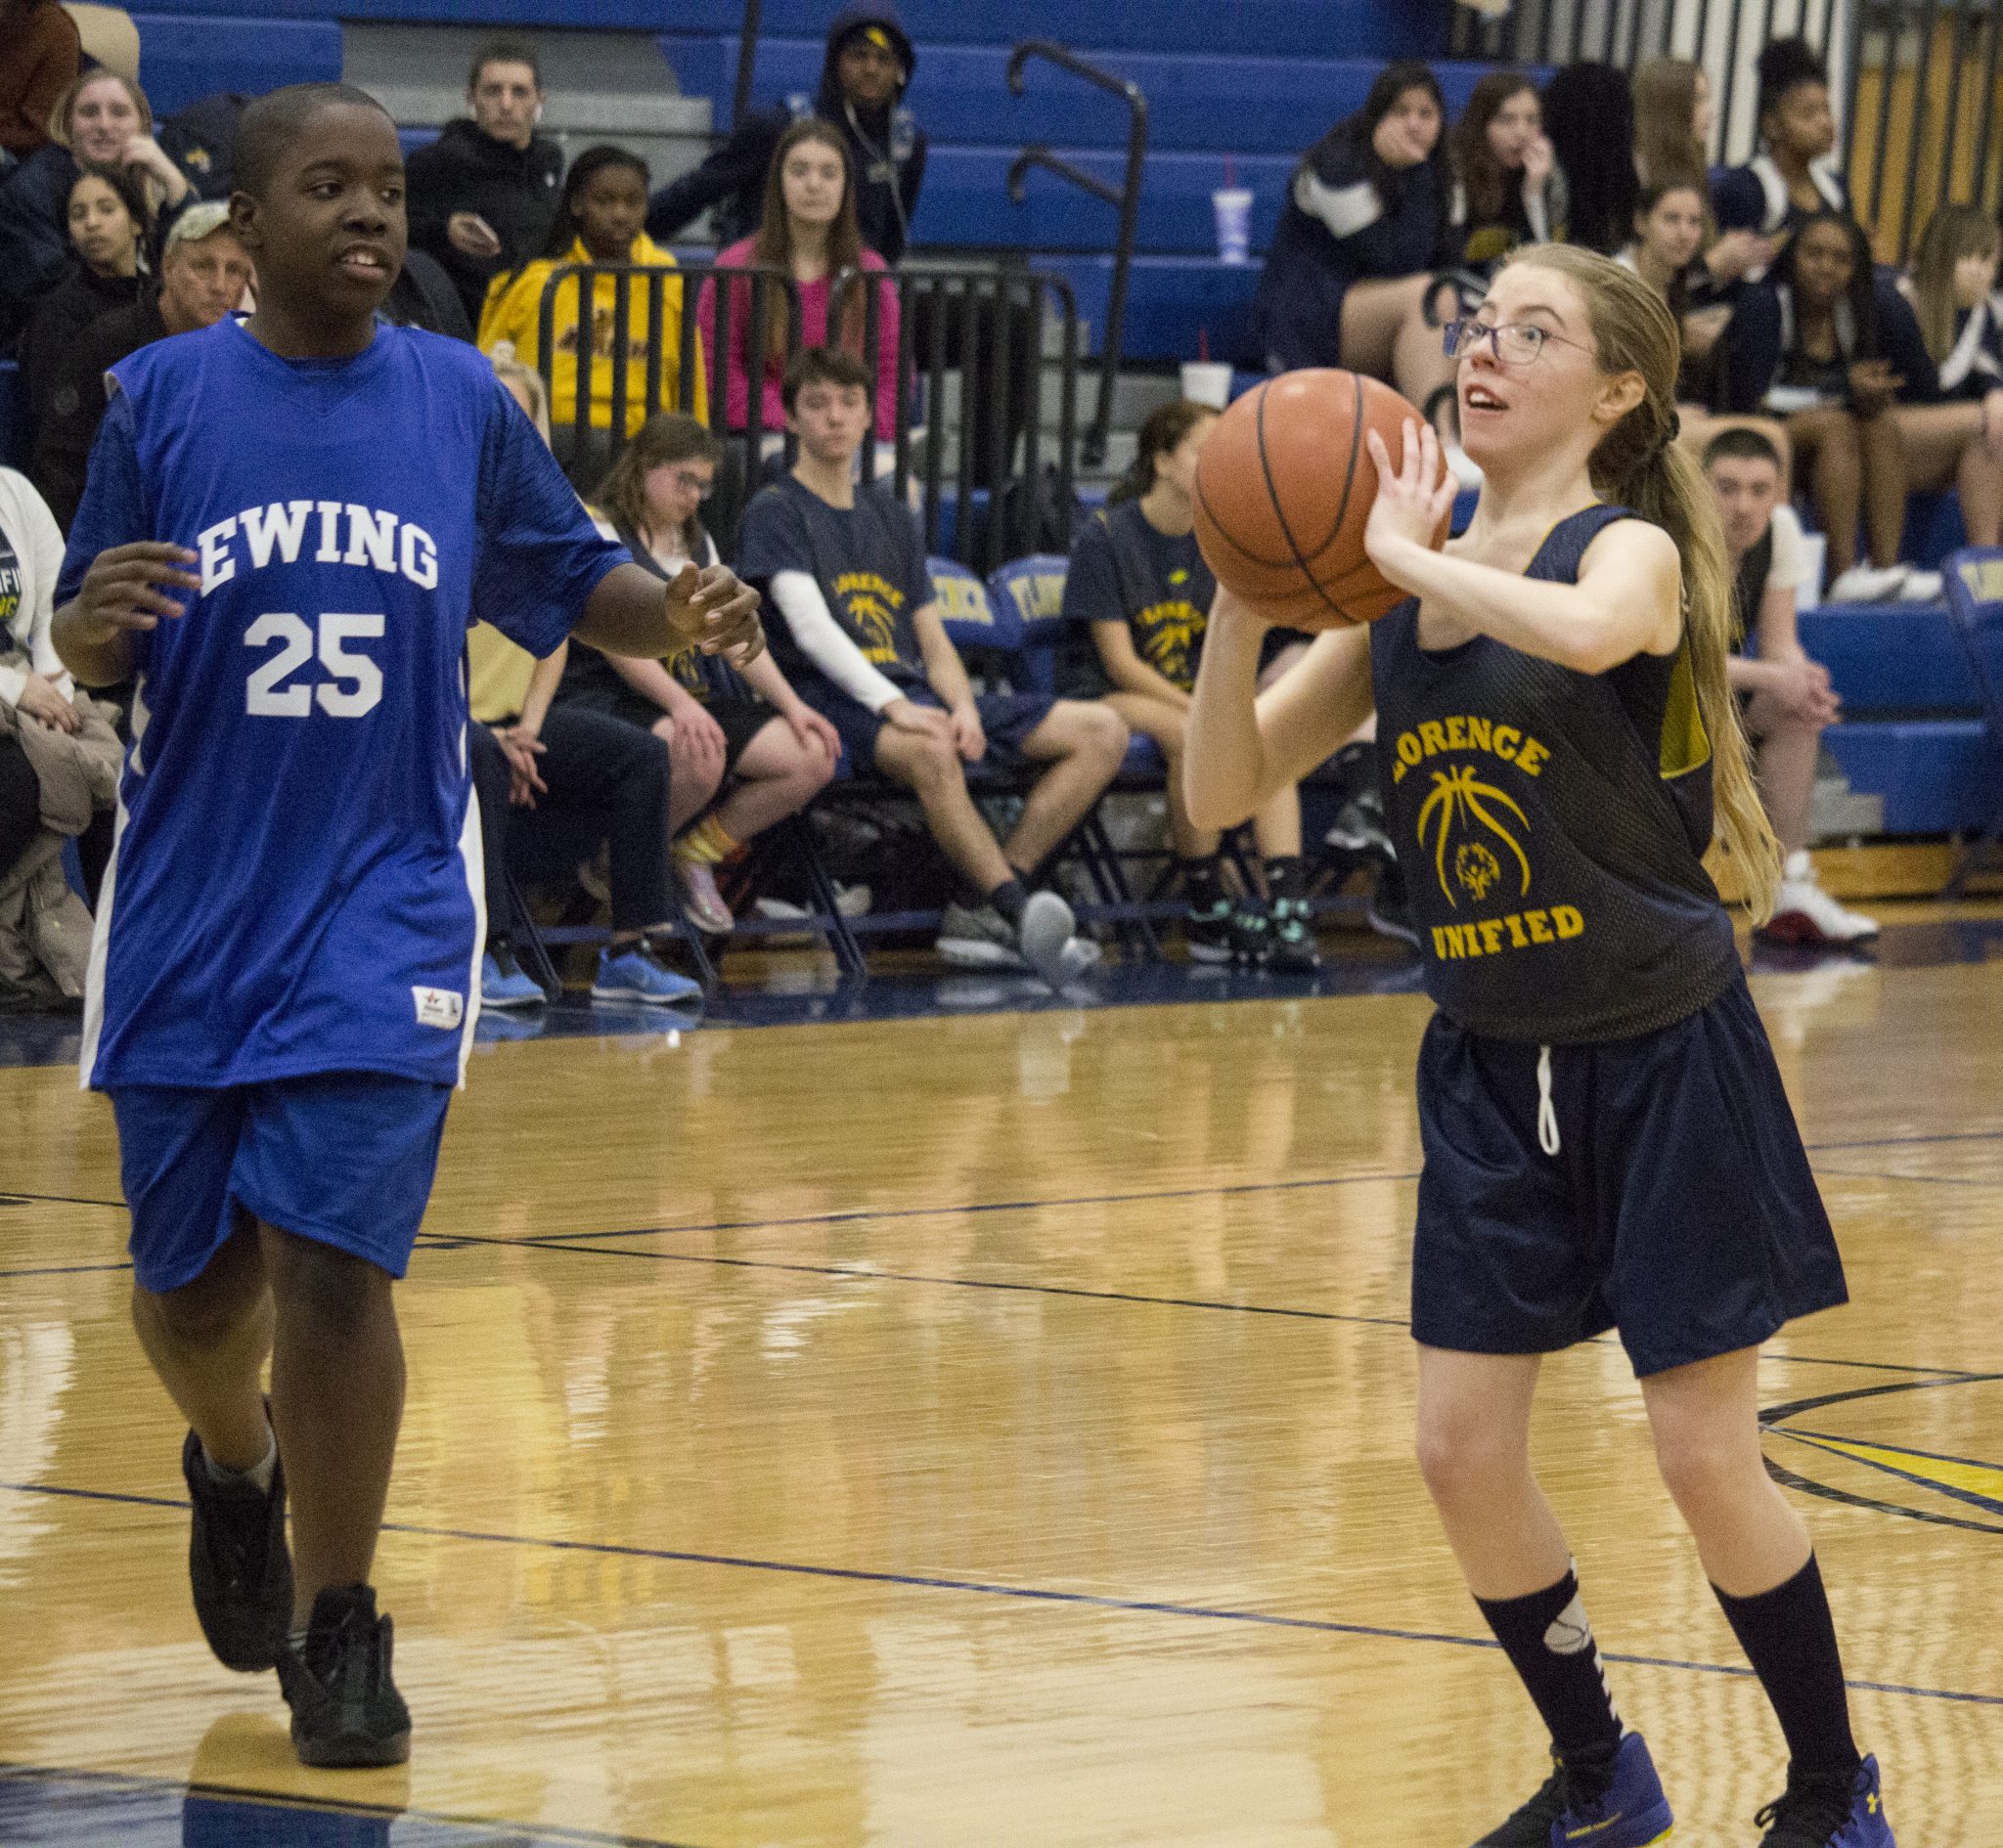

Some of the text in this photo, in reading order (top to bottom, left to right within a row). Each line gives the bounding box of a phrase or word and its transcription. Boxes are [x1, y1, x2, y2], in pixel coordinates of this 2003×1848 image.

[198, 500, 438, 597] EWING
[244, 612, 385, 718] 25
[1431, 904, 1584, 960] UNIFIED
